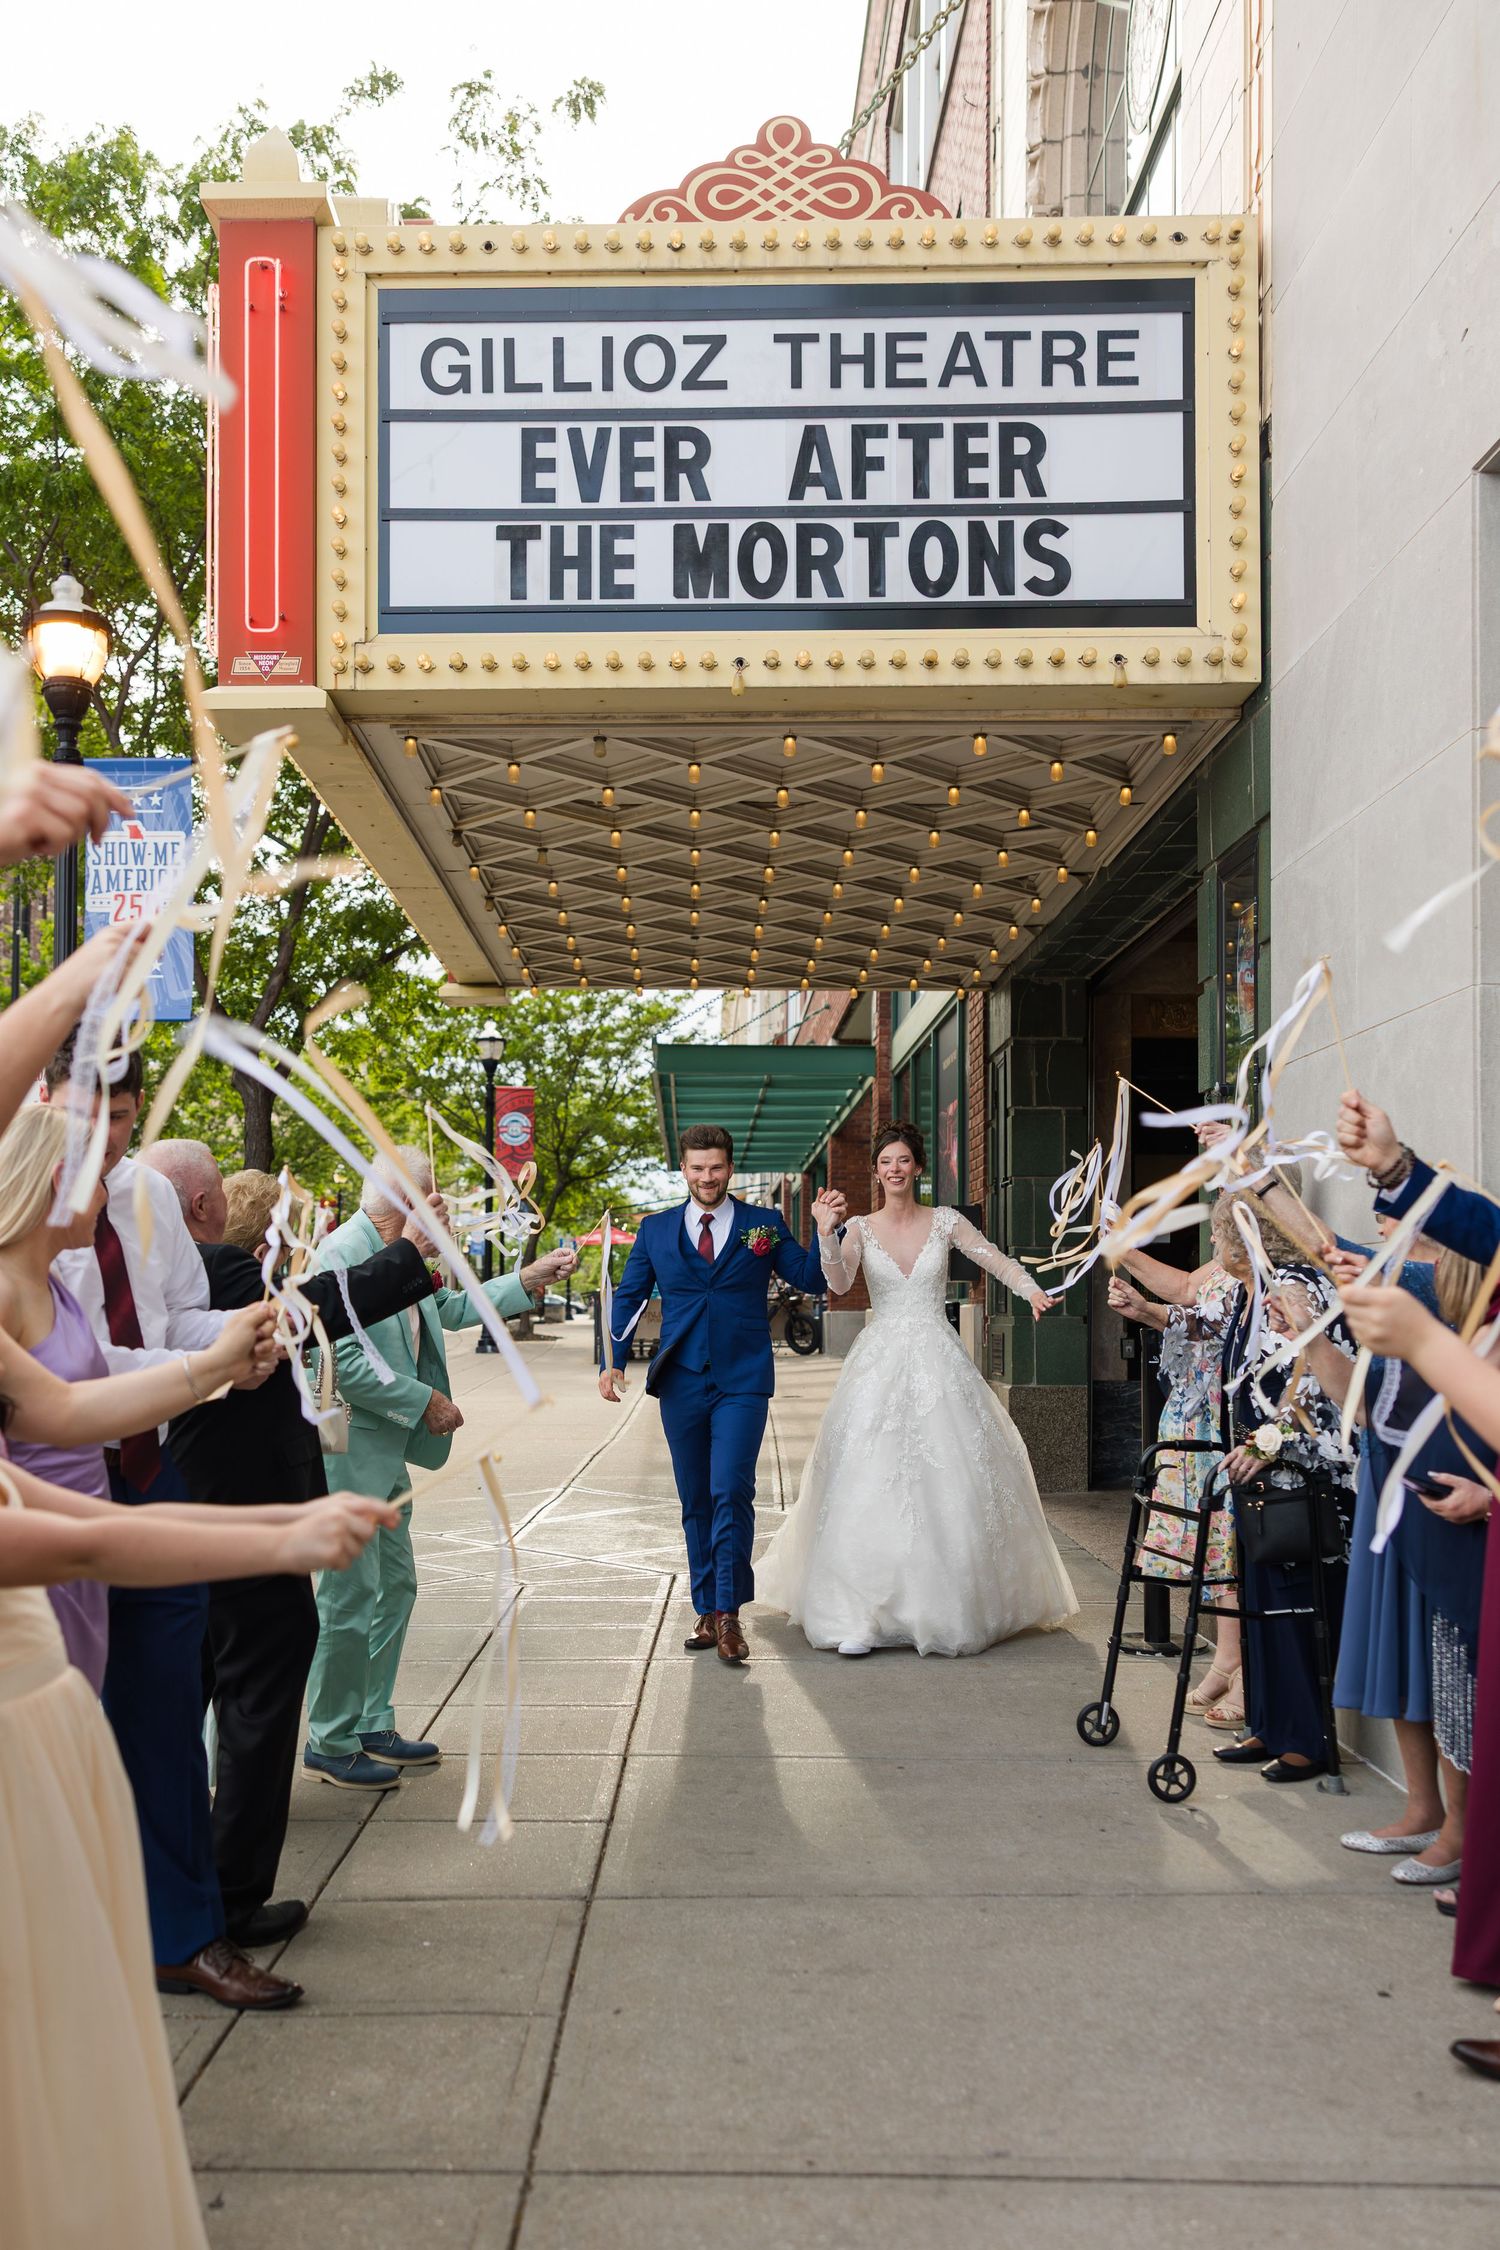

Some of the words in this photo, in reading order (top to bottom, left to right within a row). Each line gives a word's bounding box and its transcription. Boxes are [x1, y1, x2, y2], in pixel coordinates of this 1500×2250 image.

[420, 334, 728, 396] GILLIOZ
[773, 329, 1140, 389] THEATRE
[521, 426, 712, 504] EVER
[787, 421, 1048, 501] AFTER
[495, 524, 635, 601] THE
[672, 518, 1072, 600] MORTONS
[90, 868, 178, 896] AMERI
